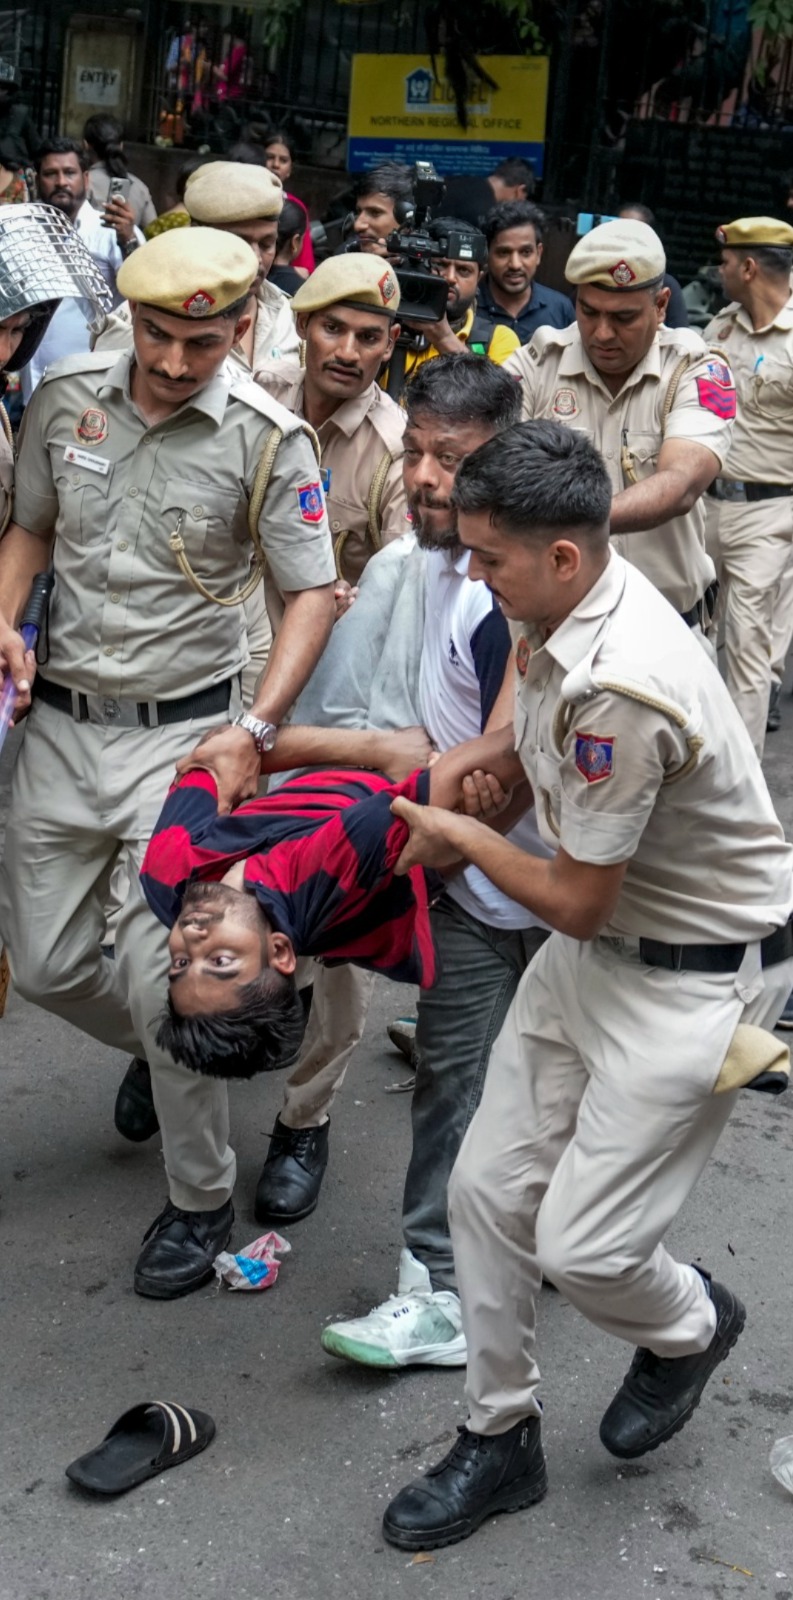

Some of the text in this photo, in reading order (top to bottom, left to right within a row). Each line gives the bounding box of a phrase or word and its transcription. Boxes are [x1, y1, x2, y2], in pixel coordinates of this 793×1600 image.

[80, 70, 117, 86] ENTRY
[370, 116, 522, 130] NORTHERN REGIOAL OFFICE
